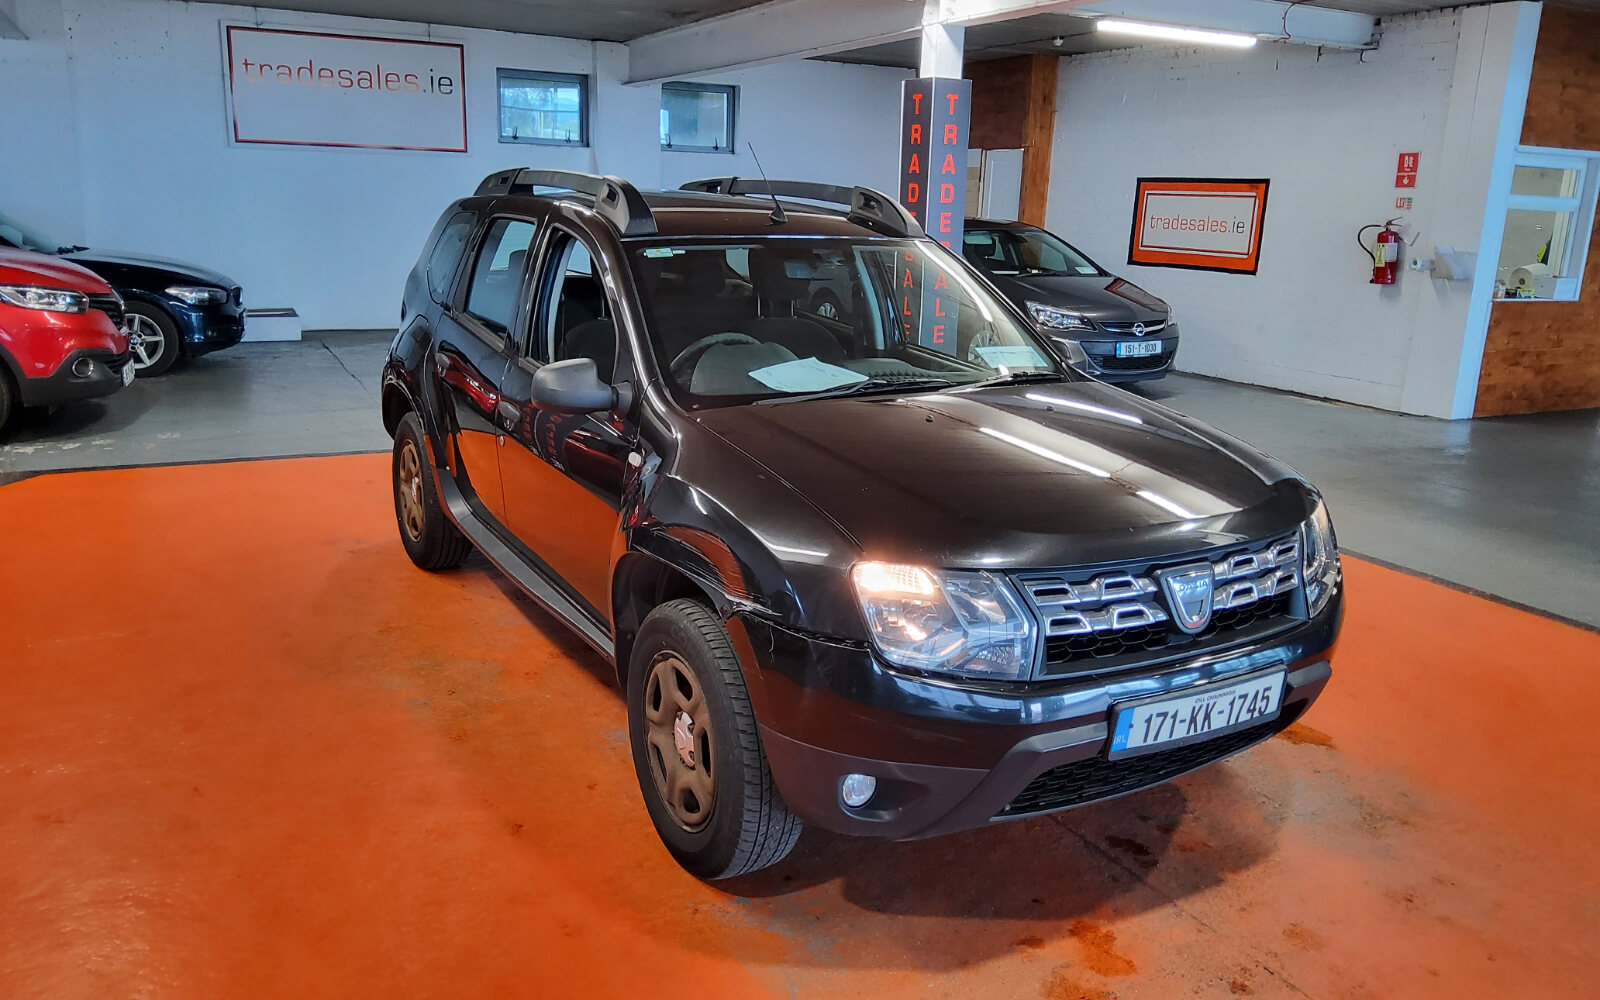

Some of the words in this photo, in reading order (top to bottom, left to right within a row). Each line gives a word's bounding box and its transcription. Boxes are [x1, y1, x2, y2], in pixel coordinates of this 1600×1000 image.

[242, 58, 453, 95] tradesales.ie
[1150, 214, 1245, 234] tradesales.ie
[1125, 343, 1156, 354] 151-T-1030
[1143, 686, 1272, 744] 171-KK-1745
